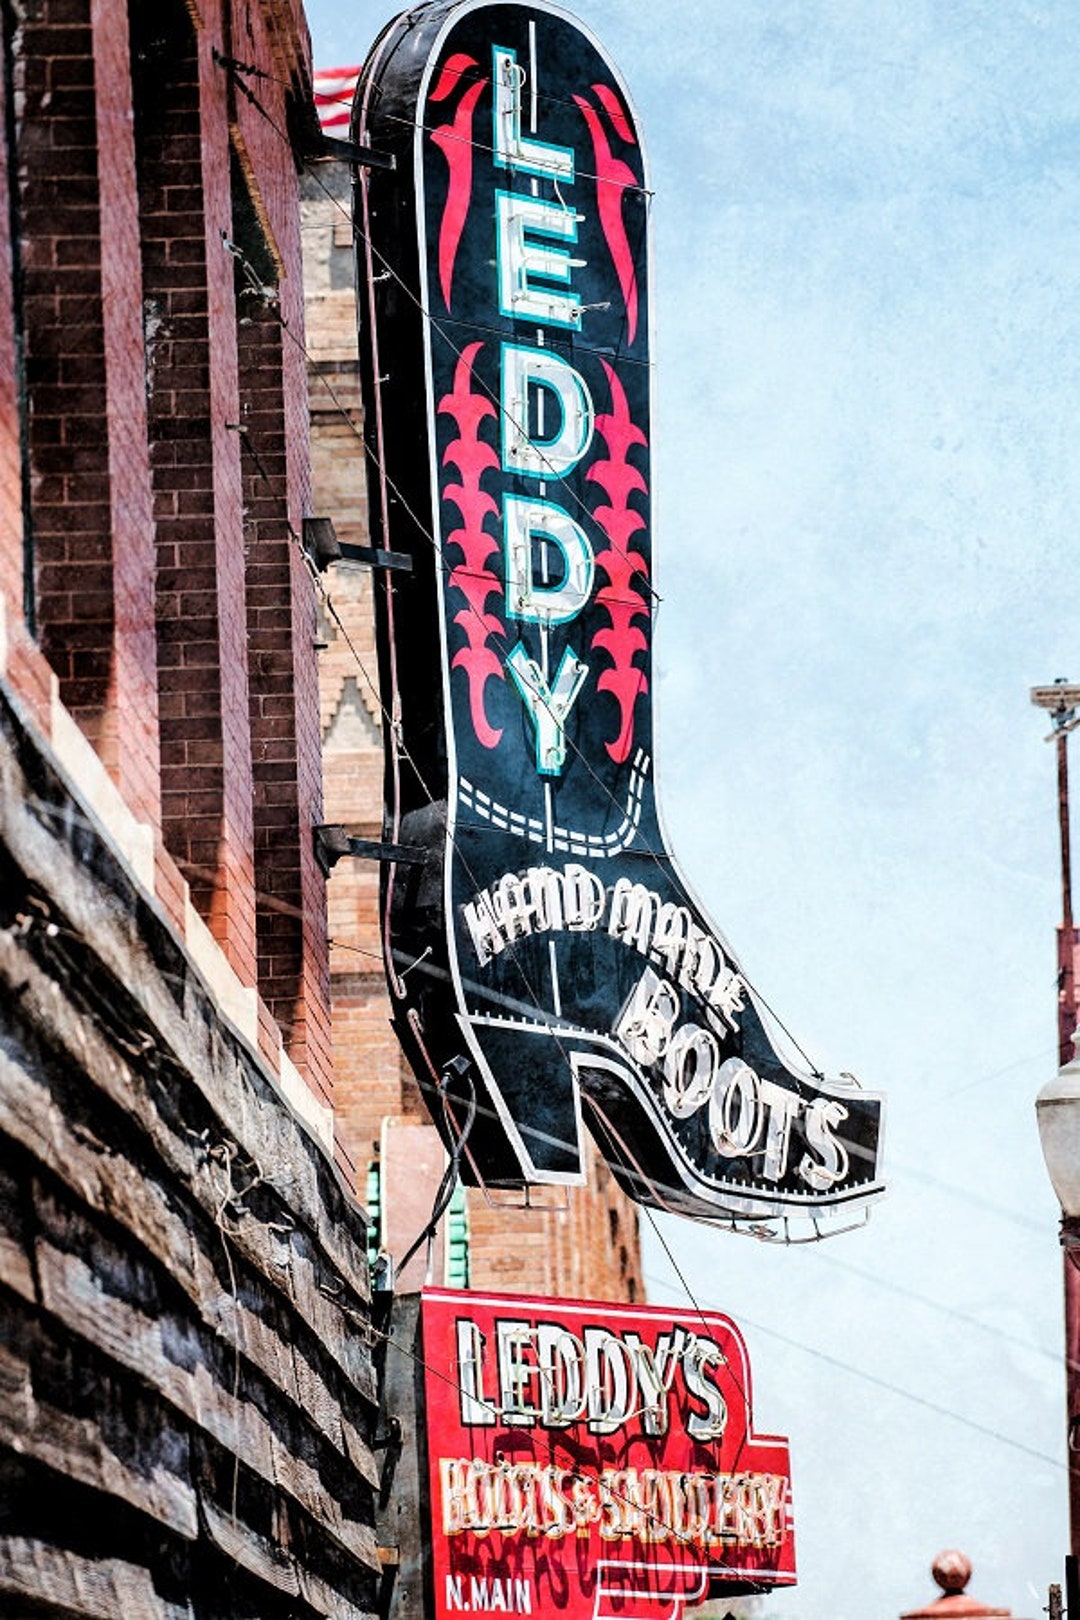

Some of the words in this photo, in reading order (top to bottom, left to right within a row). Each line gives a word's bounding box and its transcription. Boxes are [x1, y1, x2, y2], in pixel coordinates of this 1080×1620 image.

[492, 45, 596, 777] LEDDY
[463, 863, 606, 967] HAND
[608, 877, 747, 1040] MADE
[612, 965, 850, 1191] BOOTS
[455, 1318, 730, 1442] LEDDY'S
[439, 1457, 571, 1540] BOOTS
[599, 1468, 790, 1548] SADDLERY
